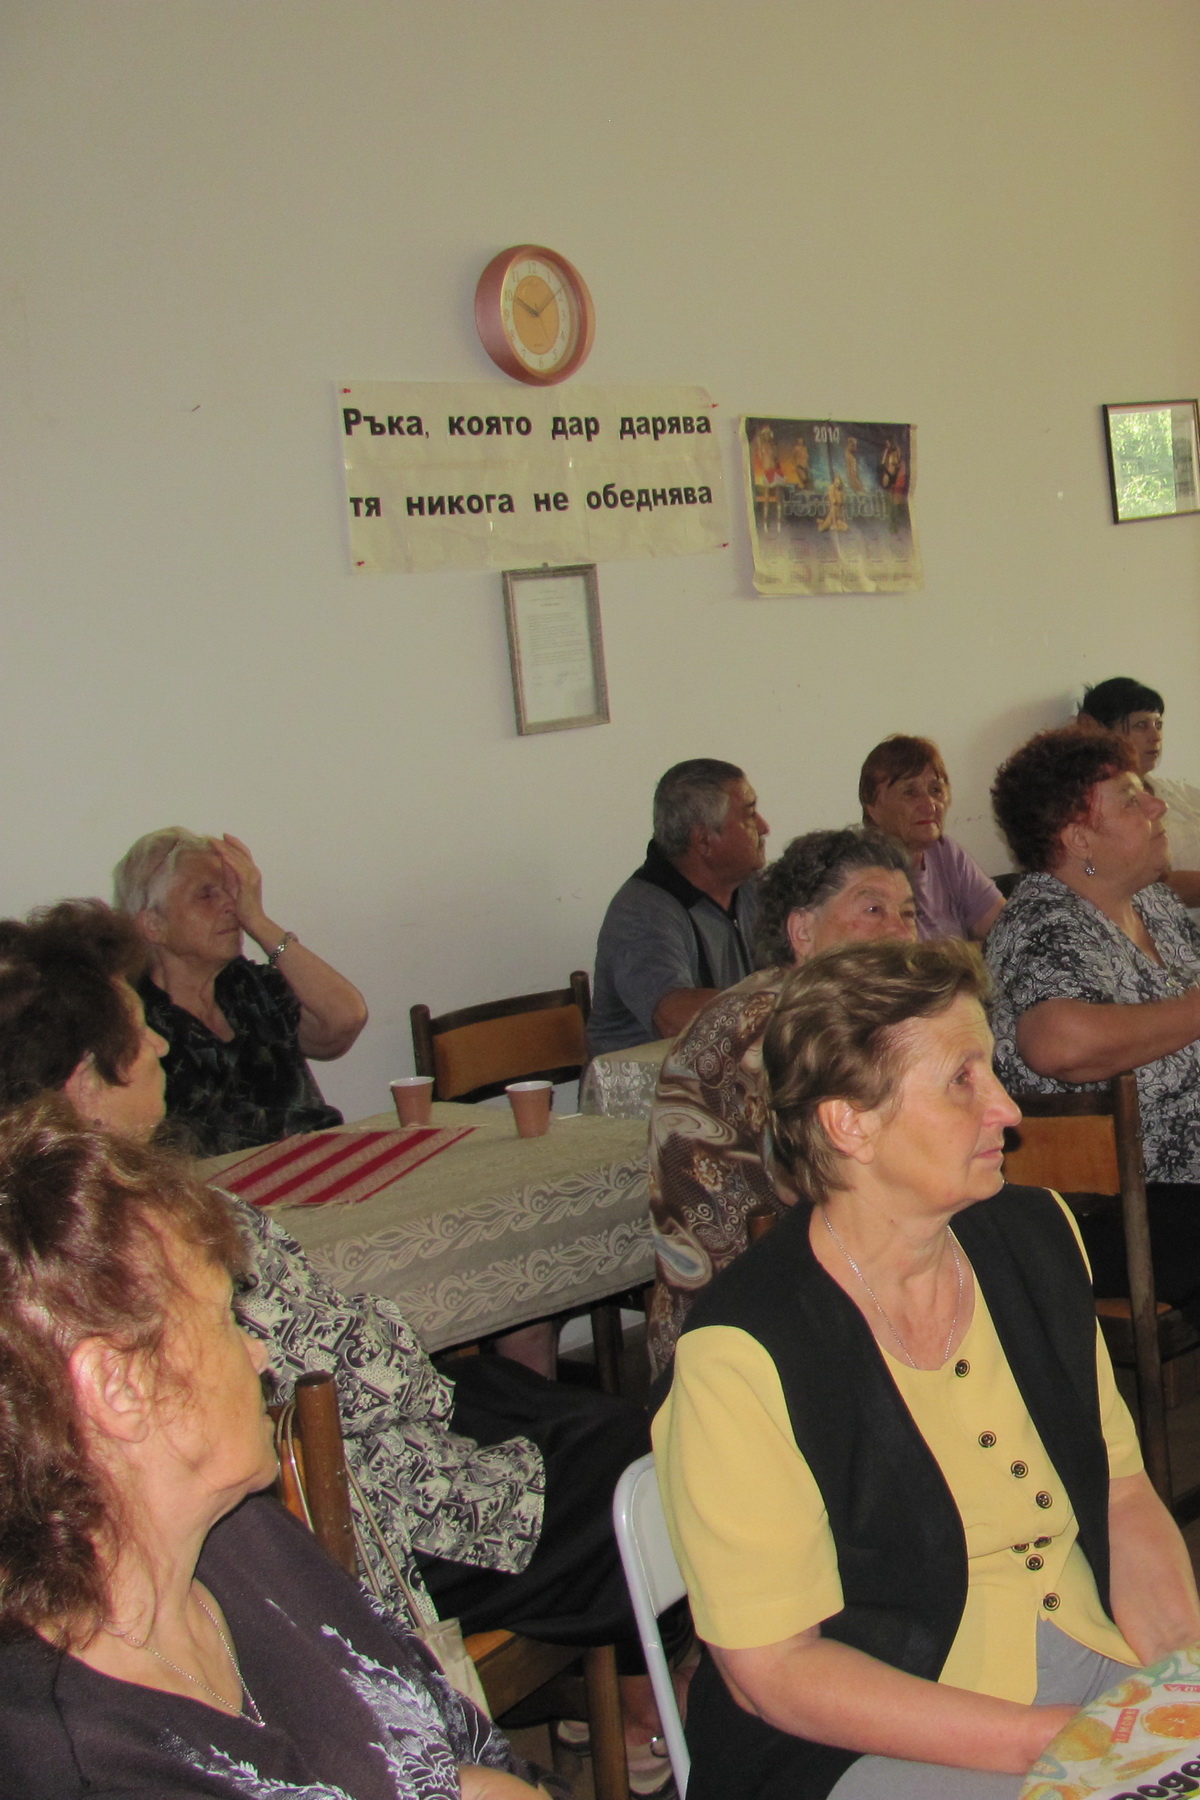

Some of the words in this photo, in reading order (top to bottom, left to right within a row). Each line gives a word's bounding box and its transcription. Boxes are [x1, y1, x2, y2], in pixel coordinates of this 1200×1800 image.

[343, 408, 429, 438] Ръка,
[448, 415, 532, 436] която
[551, 416, 600, 441] дар
[619, 415, 711, 441] дарява
[349, 496, 382, 517] тя
[406, 493, 515, 516] никога
[533, 490, 569, 512] не
[586, 484, 713, 512] обеднява
